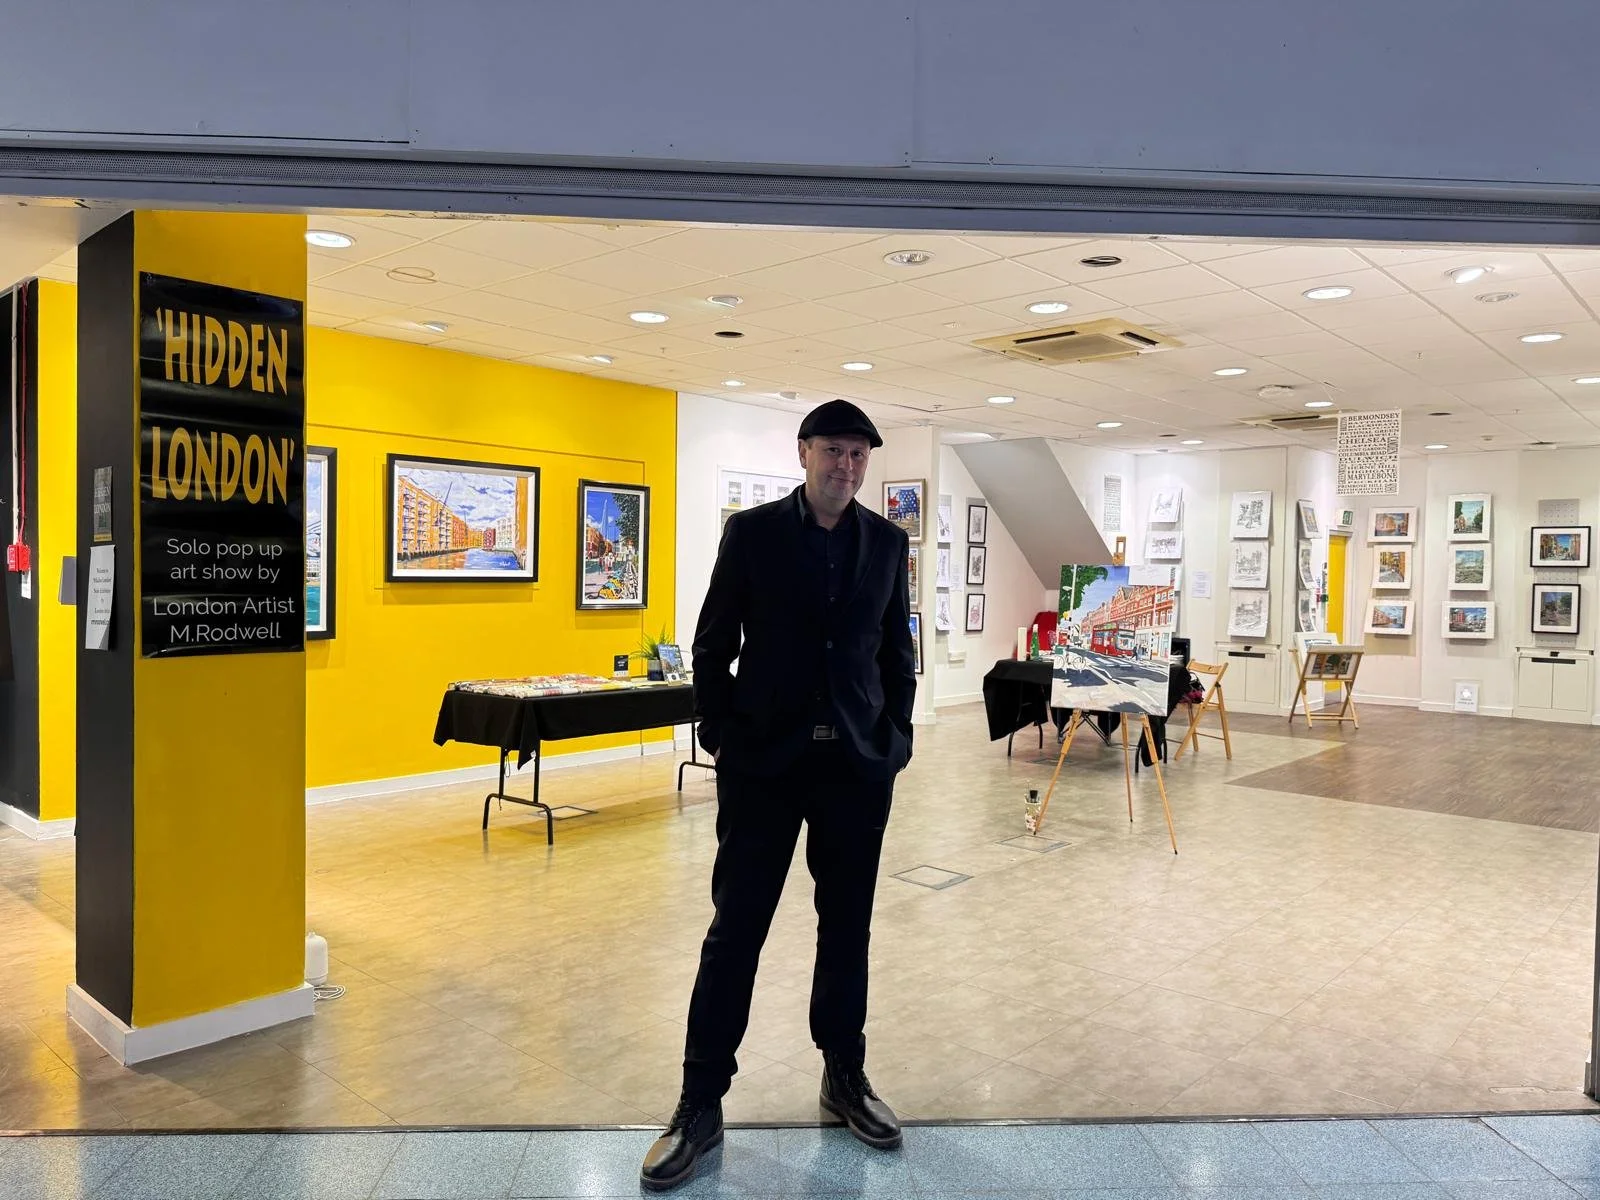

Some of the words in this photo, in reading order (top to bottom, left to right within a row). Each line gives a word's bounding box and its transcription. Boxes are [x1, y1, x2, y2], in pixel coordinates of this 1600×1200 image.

[156, 307, 288, 395] 'HIDDEN
[1348, 413, 1399, 421] BERMONDSEY
[152, 426, 295, 506] LONDON'
[1347, 472, 1397, 480] MARYLEBONE
[167, 538, 211, 555] Solo
[216, 543, 254, 559] pop
[259, 544, 283, 560] up
[170, 564, 197, 579] art
[202, 564, 252, 579] show
[258, 564, 280, 583] by
[154, 597, 237, 616] London
[242, 596, 295, 614] Artist
[170, 622, 281, 643] M.Rodwell
